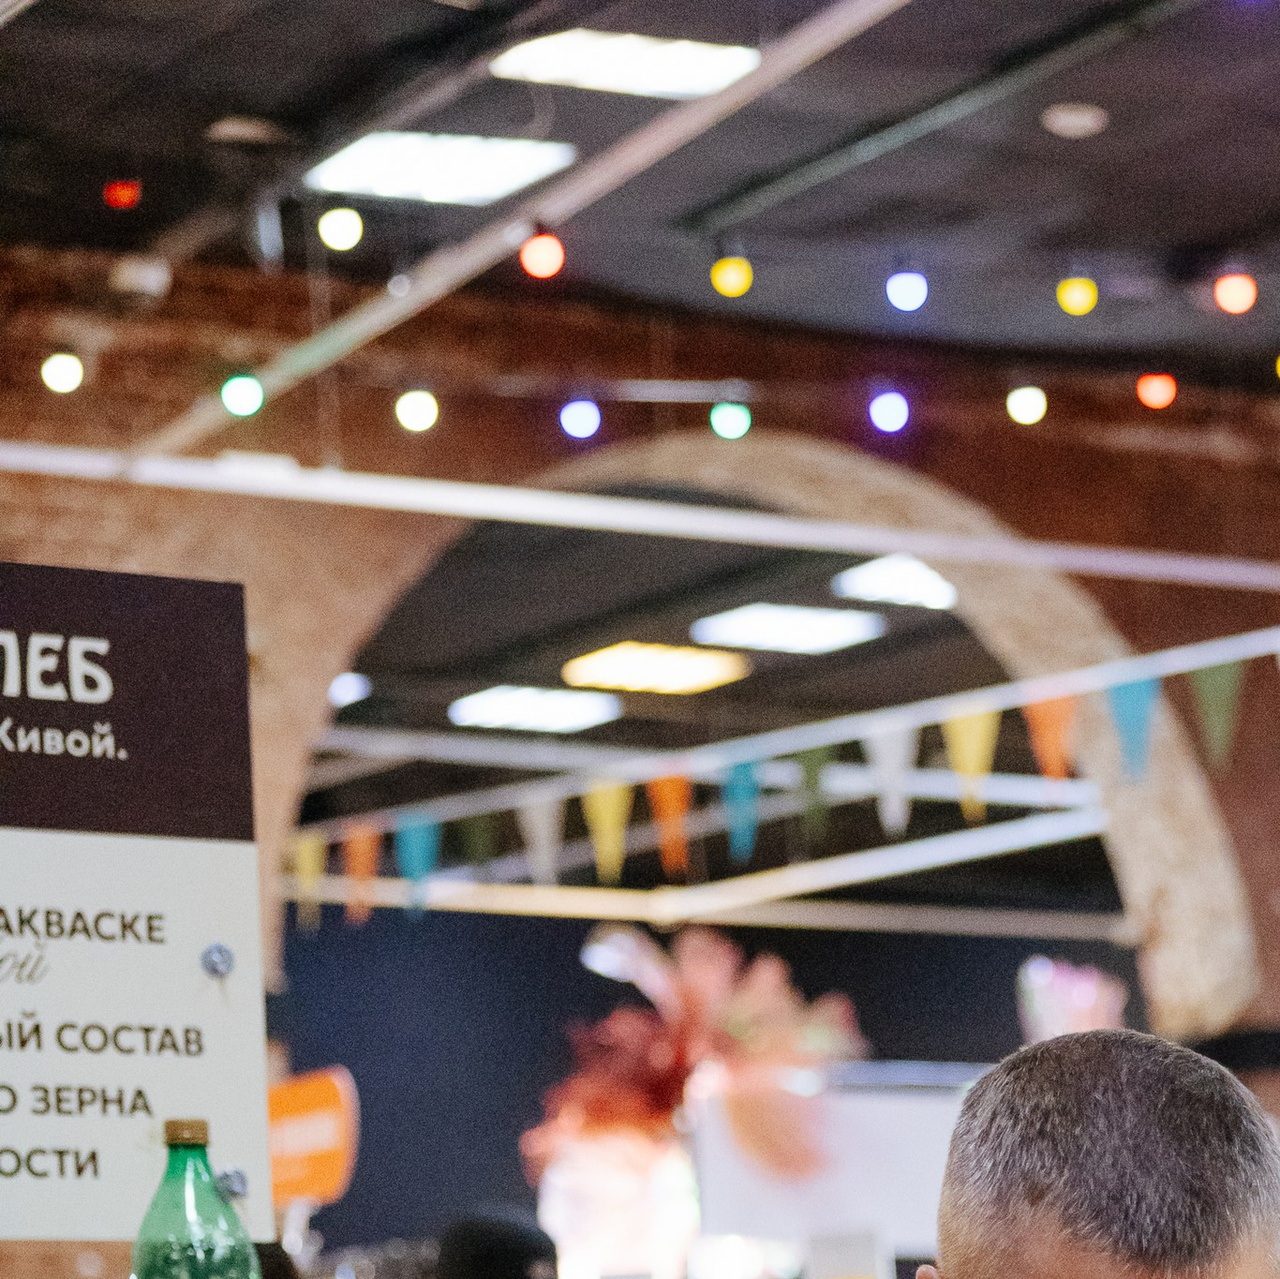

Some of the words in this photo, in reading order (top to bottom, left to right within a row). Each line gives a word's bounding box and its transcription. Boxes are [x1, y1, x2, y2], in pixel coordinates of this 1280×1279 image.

[0, 908, 165, 944] АКВАСКЕ
[56, 1022, 203, 1056] СОСТАВ
[30, 1084, 153, 1117] ЗЕРНА
[0, 1148, 99, 1178] ОСТИ
